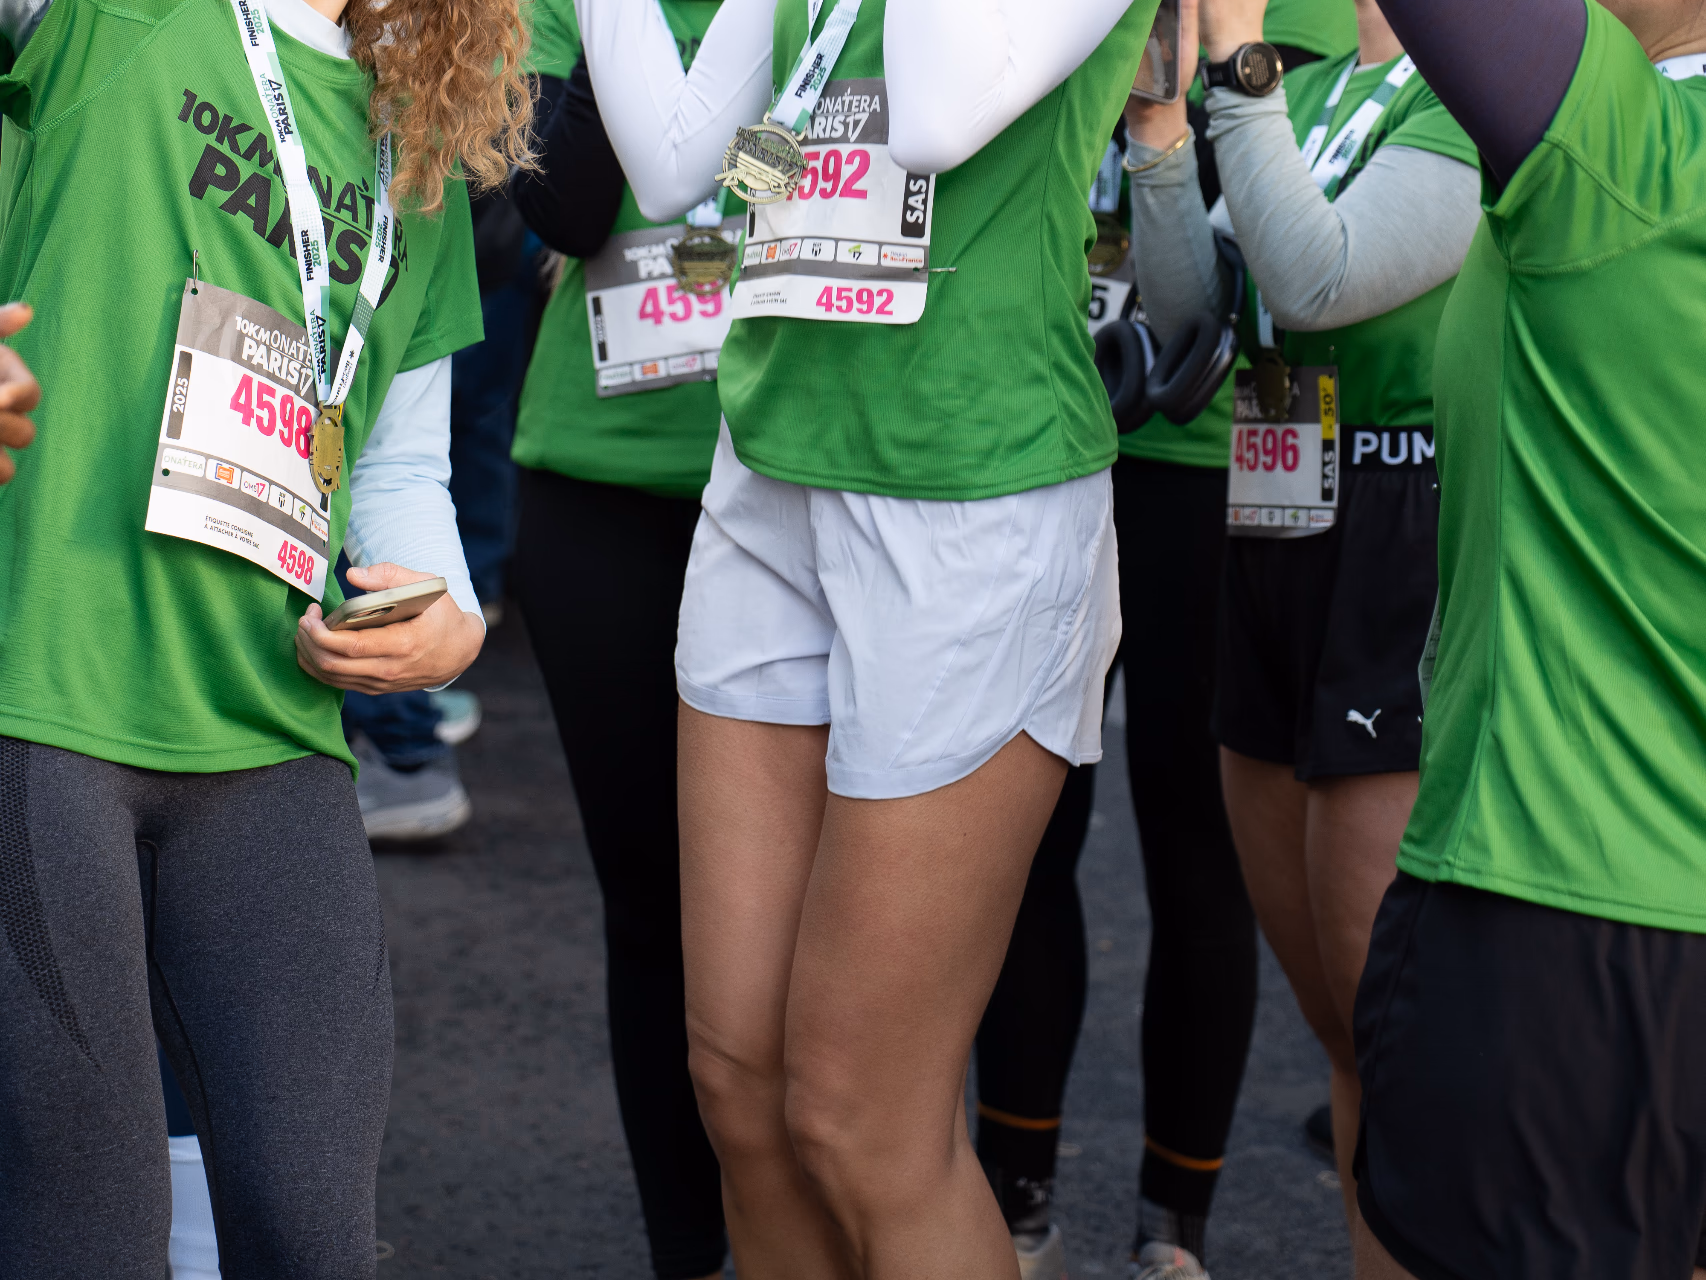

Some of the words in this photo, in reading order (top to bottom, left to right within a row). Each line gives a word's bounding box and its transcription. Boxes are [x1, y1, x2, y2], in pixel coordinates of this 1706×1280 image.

[239, 0, 259, 46] FINISHER
[250, 8, 264, 34] 2025
[795, 53, 824, 98] FINISHER
[810, 67, 827, 92] 2025
[803, 111, 869, 142] ARIS17
[906, 179, 927, 224] SAS
[311, 239, 321, 267] 2025
[375, 221, 383, 248] 2025
[378, 215, 389, 263] FINISHER
[301, 229, 315, 281] FINISHER
[639, 280, 723, 325] 459
[815, 285, 894, 315] 4592
[172, 377, 189, 414] 2025
[230, 373, 312, 460] 4598
[163, 455, 204, 471] ONATERA
[1235, 428, 1300, 472] 4596
[1353, 431, 1435, 465] PUM
[1323, 449, 1335, 489] SAS
[278, 540, 315, 585] 4598
